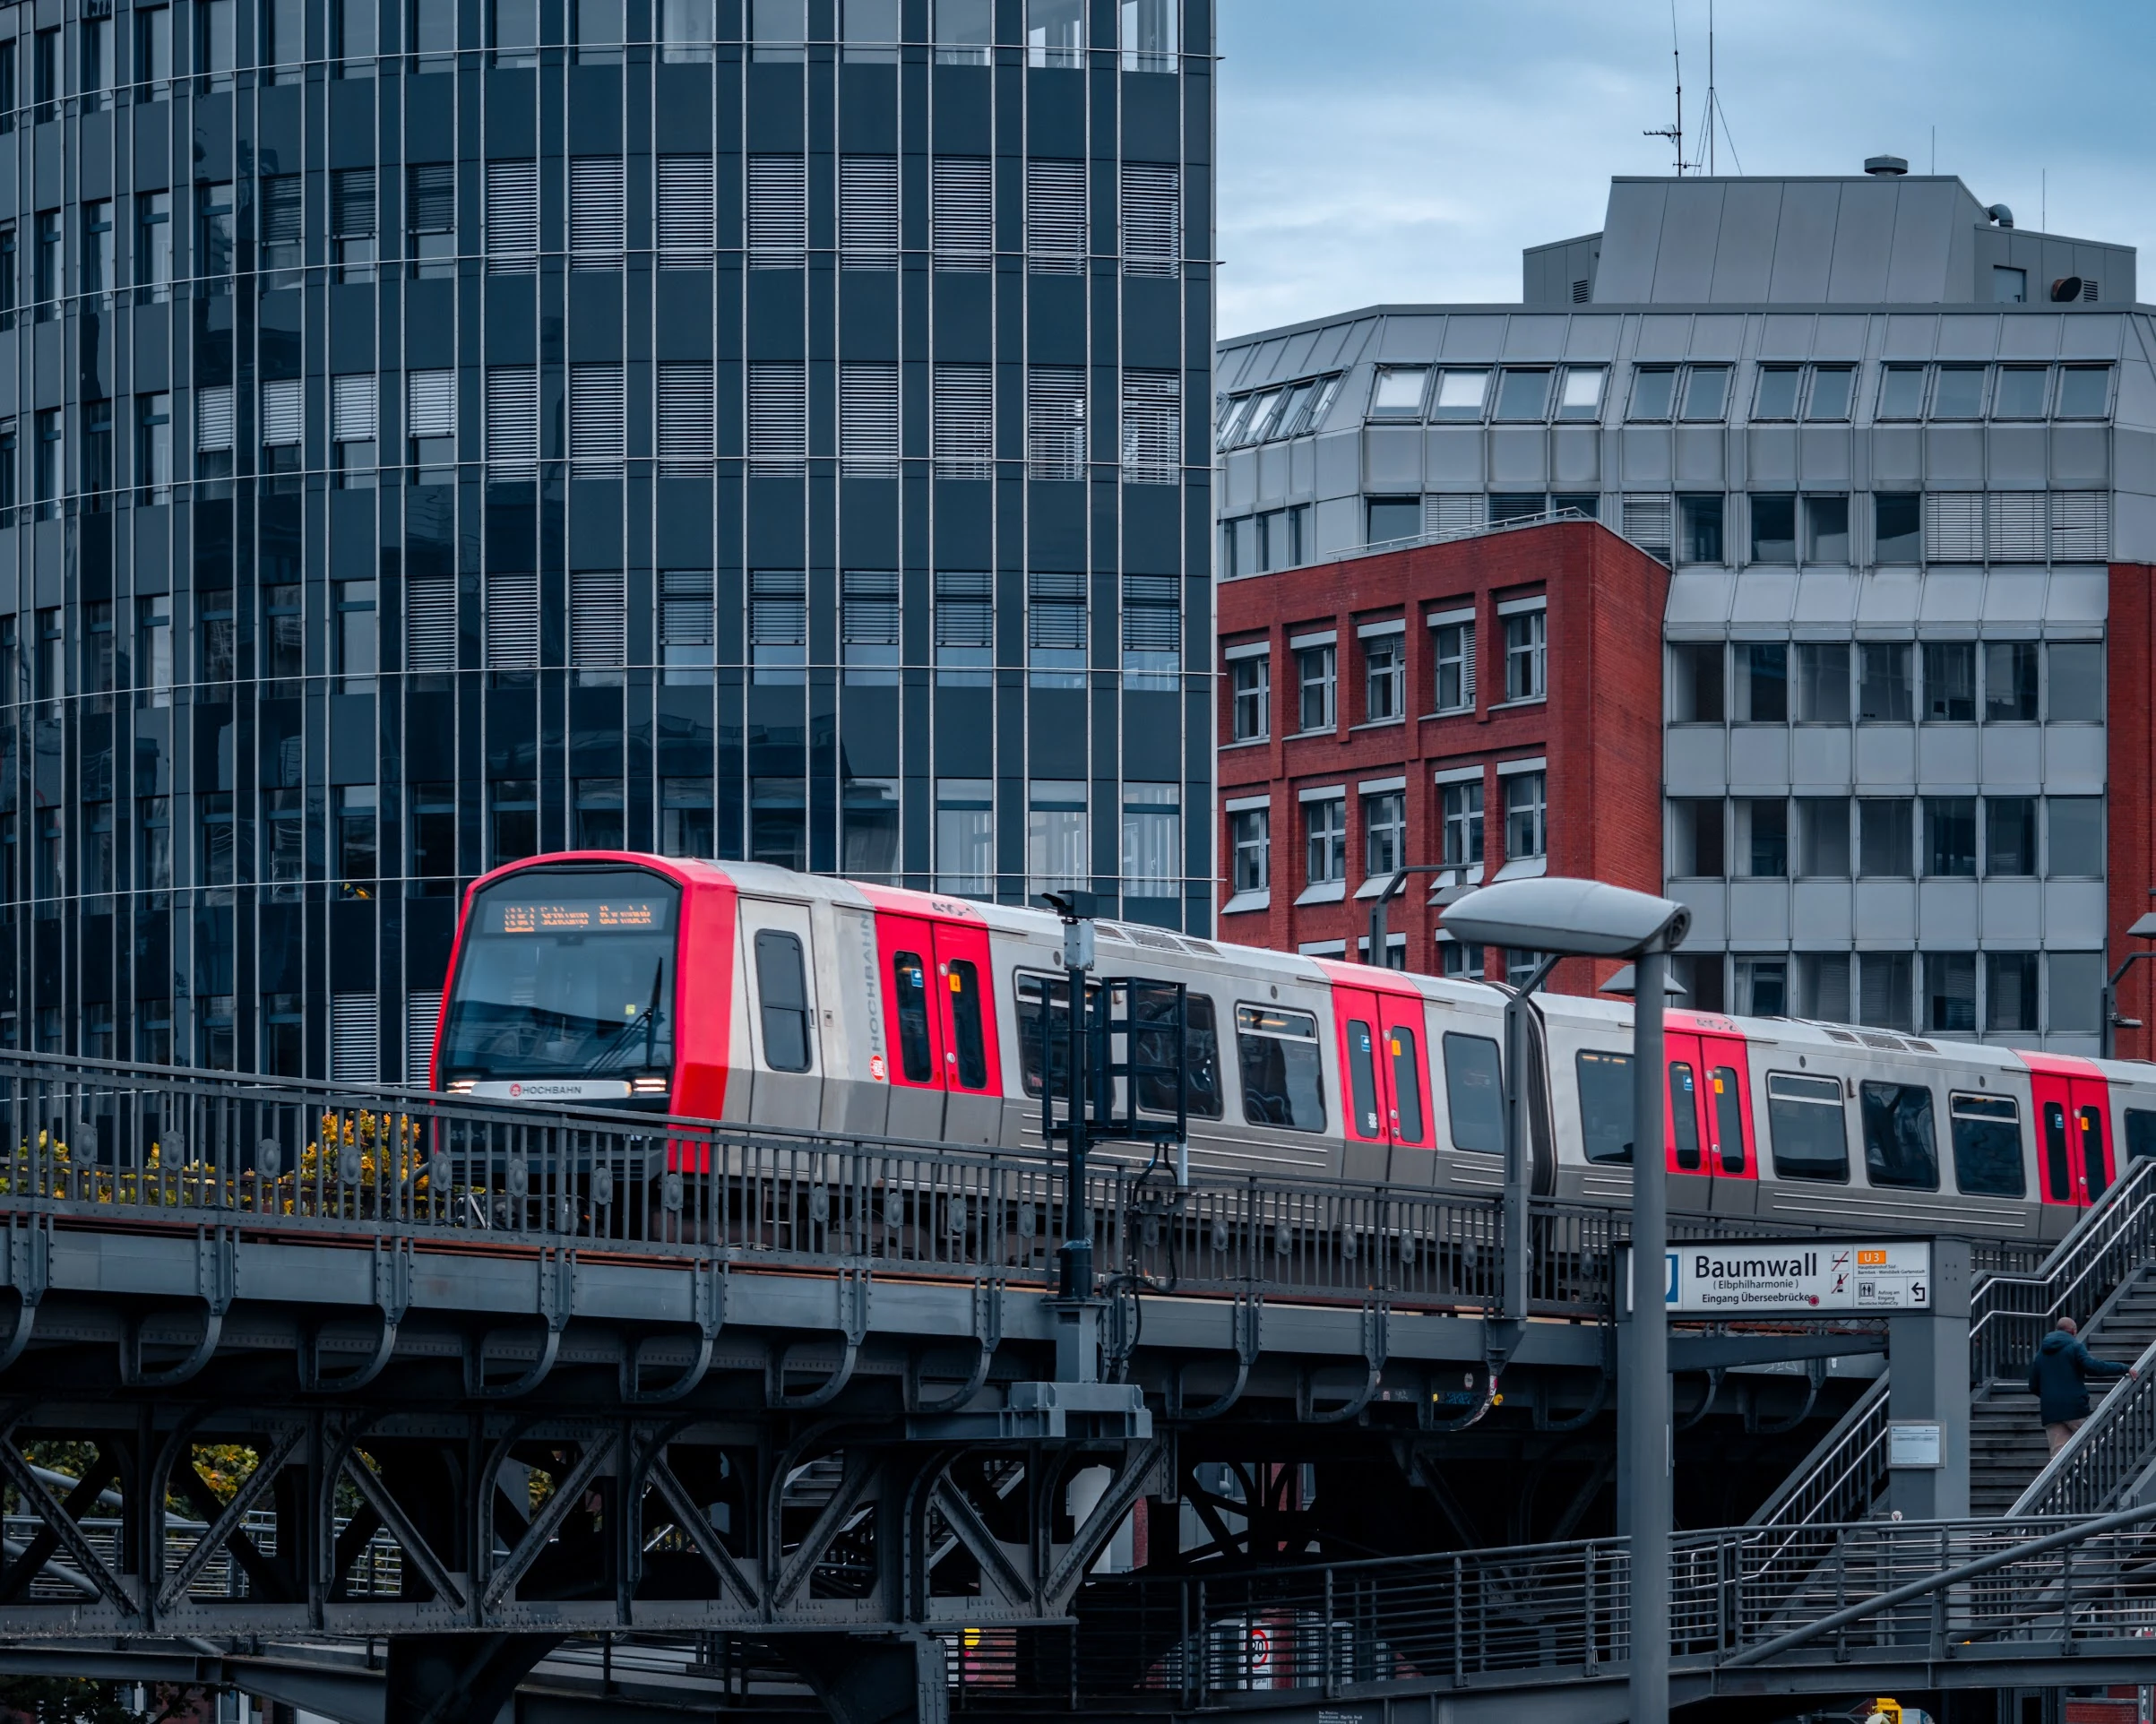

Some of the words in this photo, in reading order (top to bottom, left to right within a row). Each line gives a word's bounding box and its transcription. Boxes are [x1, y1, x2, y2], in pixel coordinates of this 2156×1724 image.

[860, 913, 882, 1051] HOCHBAHN
[522, 1086, 582, 1094] HOCHBAHN
[1695, 1252, 1817, 1279] Baumwall
[1703, 1294, 1738, 1305] Eingang
[1741, 1292, 1810, 1303] Überseebrücke
